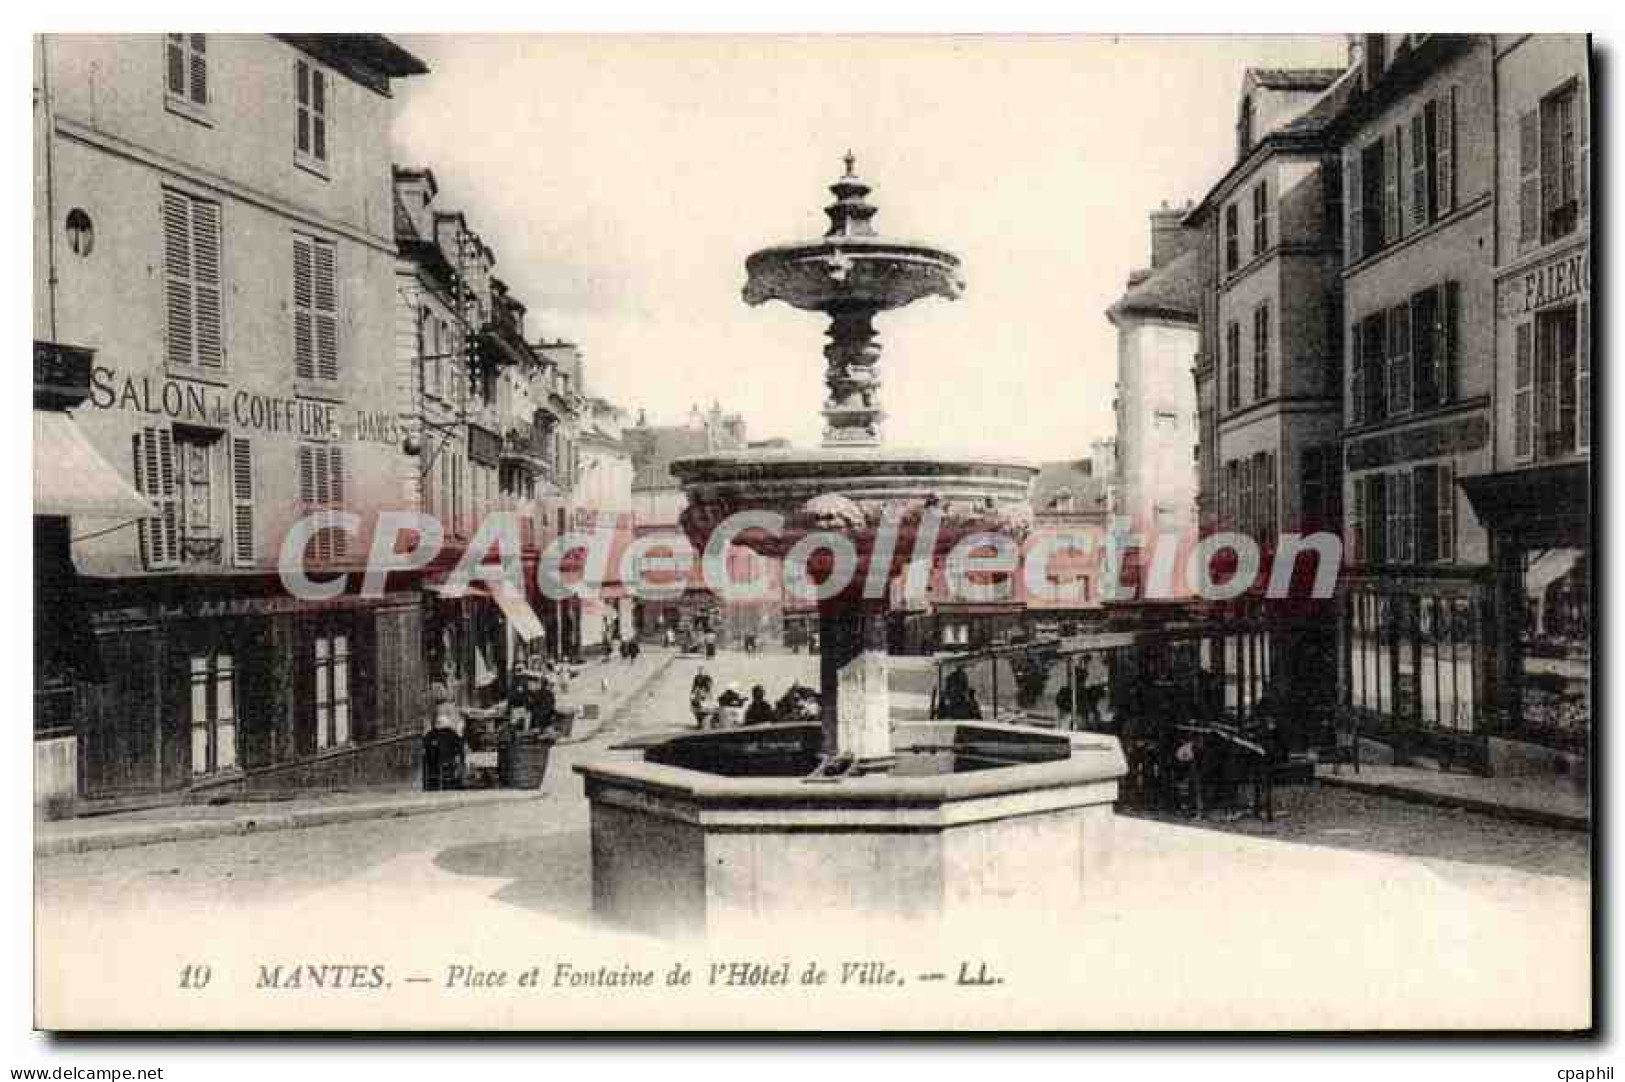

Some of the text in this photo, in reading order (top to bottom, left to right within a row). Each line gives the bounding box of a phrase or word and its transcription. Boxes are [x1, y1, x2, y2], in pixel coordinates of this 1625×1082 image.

[1525, 254, 1589, 311] FAIEN
[90, 366, 205, 420] SALON
[234, 390, 338, 438] COIFFURE
